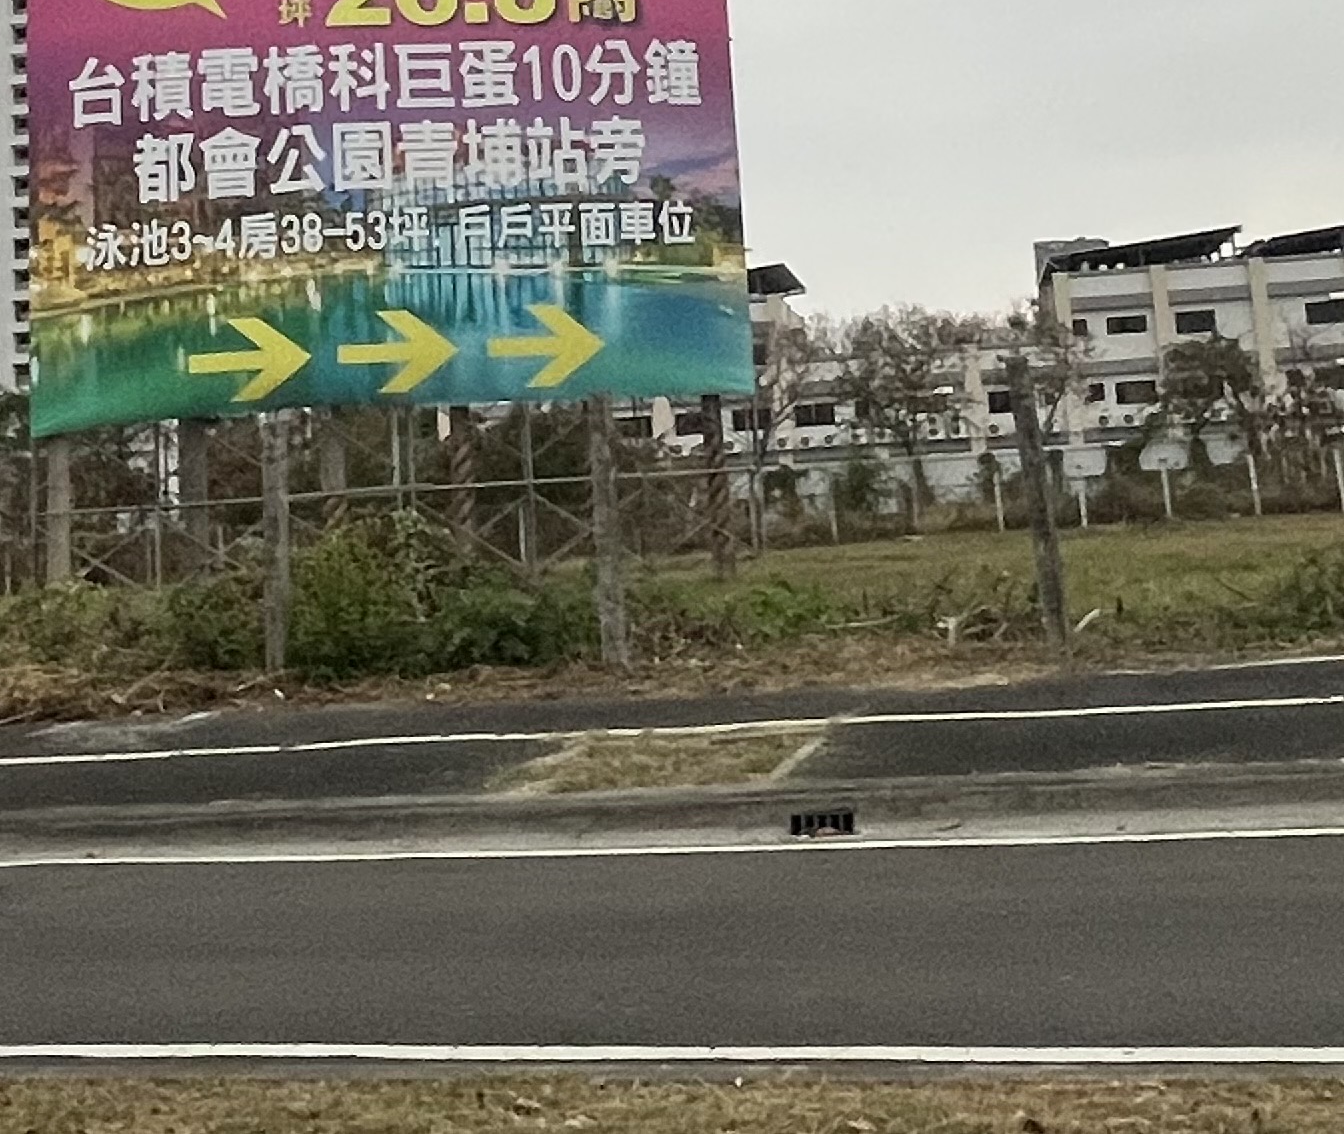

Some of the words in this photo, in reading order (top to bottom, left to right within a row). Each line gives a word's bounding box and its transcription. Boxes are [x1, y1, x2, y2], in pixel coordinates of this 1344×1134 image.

[67, 38, 704, 129] 台積電橋科巨蛋10分鐘
[133, 115, 646, 205] 都會公園青埔站旁
